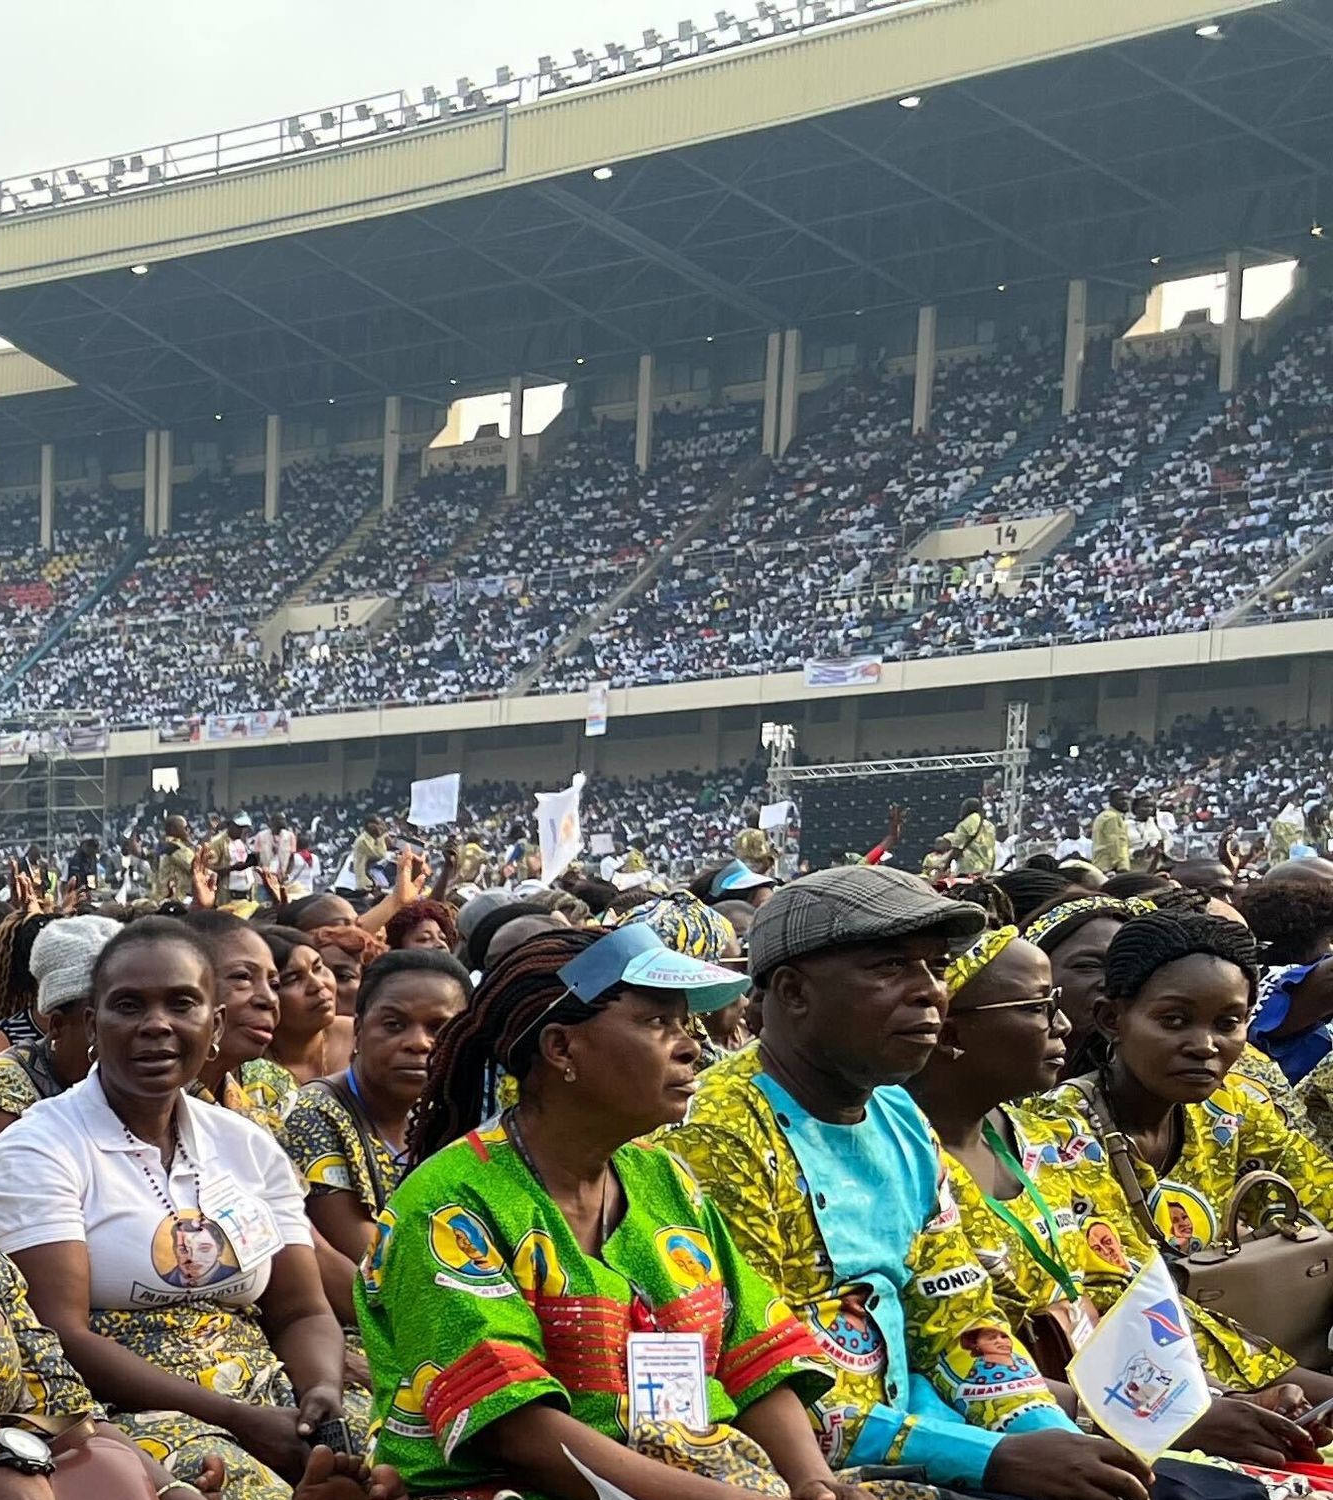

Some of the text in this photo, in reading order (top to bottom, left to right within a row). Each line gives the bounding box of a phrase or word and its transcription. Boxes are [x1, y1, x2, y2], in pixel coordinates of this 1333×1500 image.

[995, 525, 1017, 545] 14
[333, 605, 349, 622] 15
[139, 1290, 172, 1304] PAPA
[820, 1339, 856, 1367] MAMAN
[962, 1384, 1003, 1398] MAMAN
